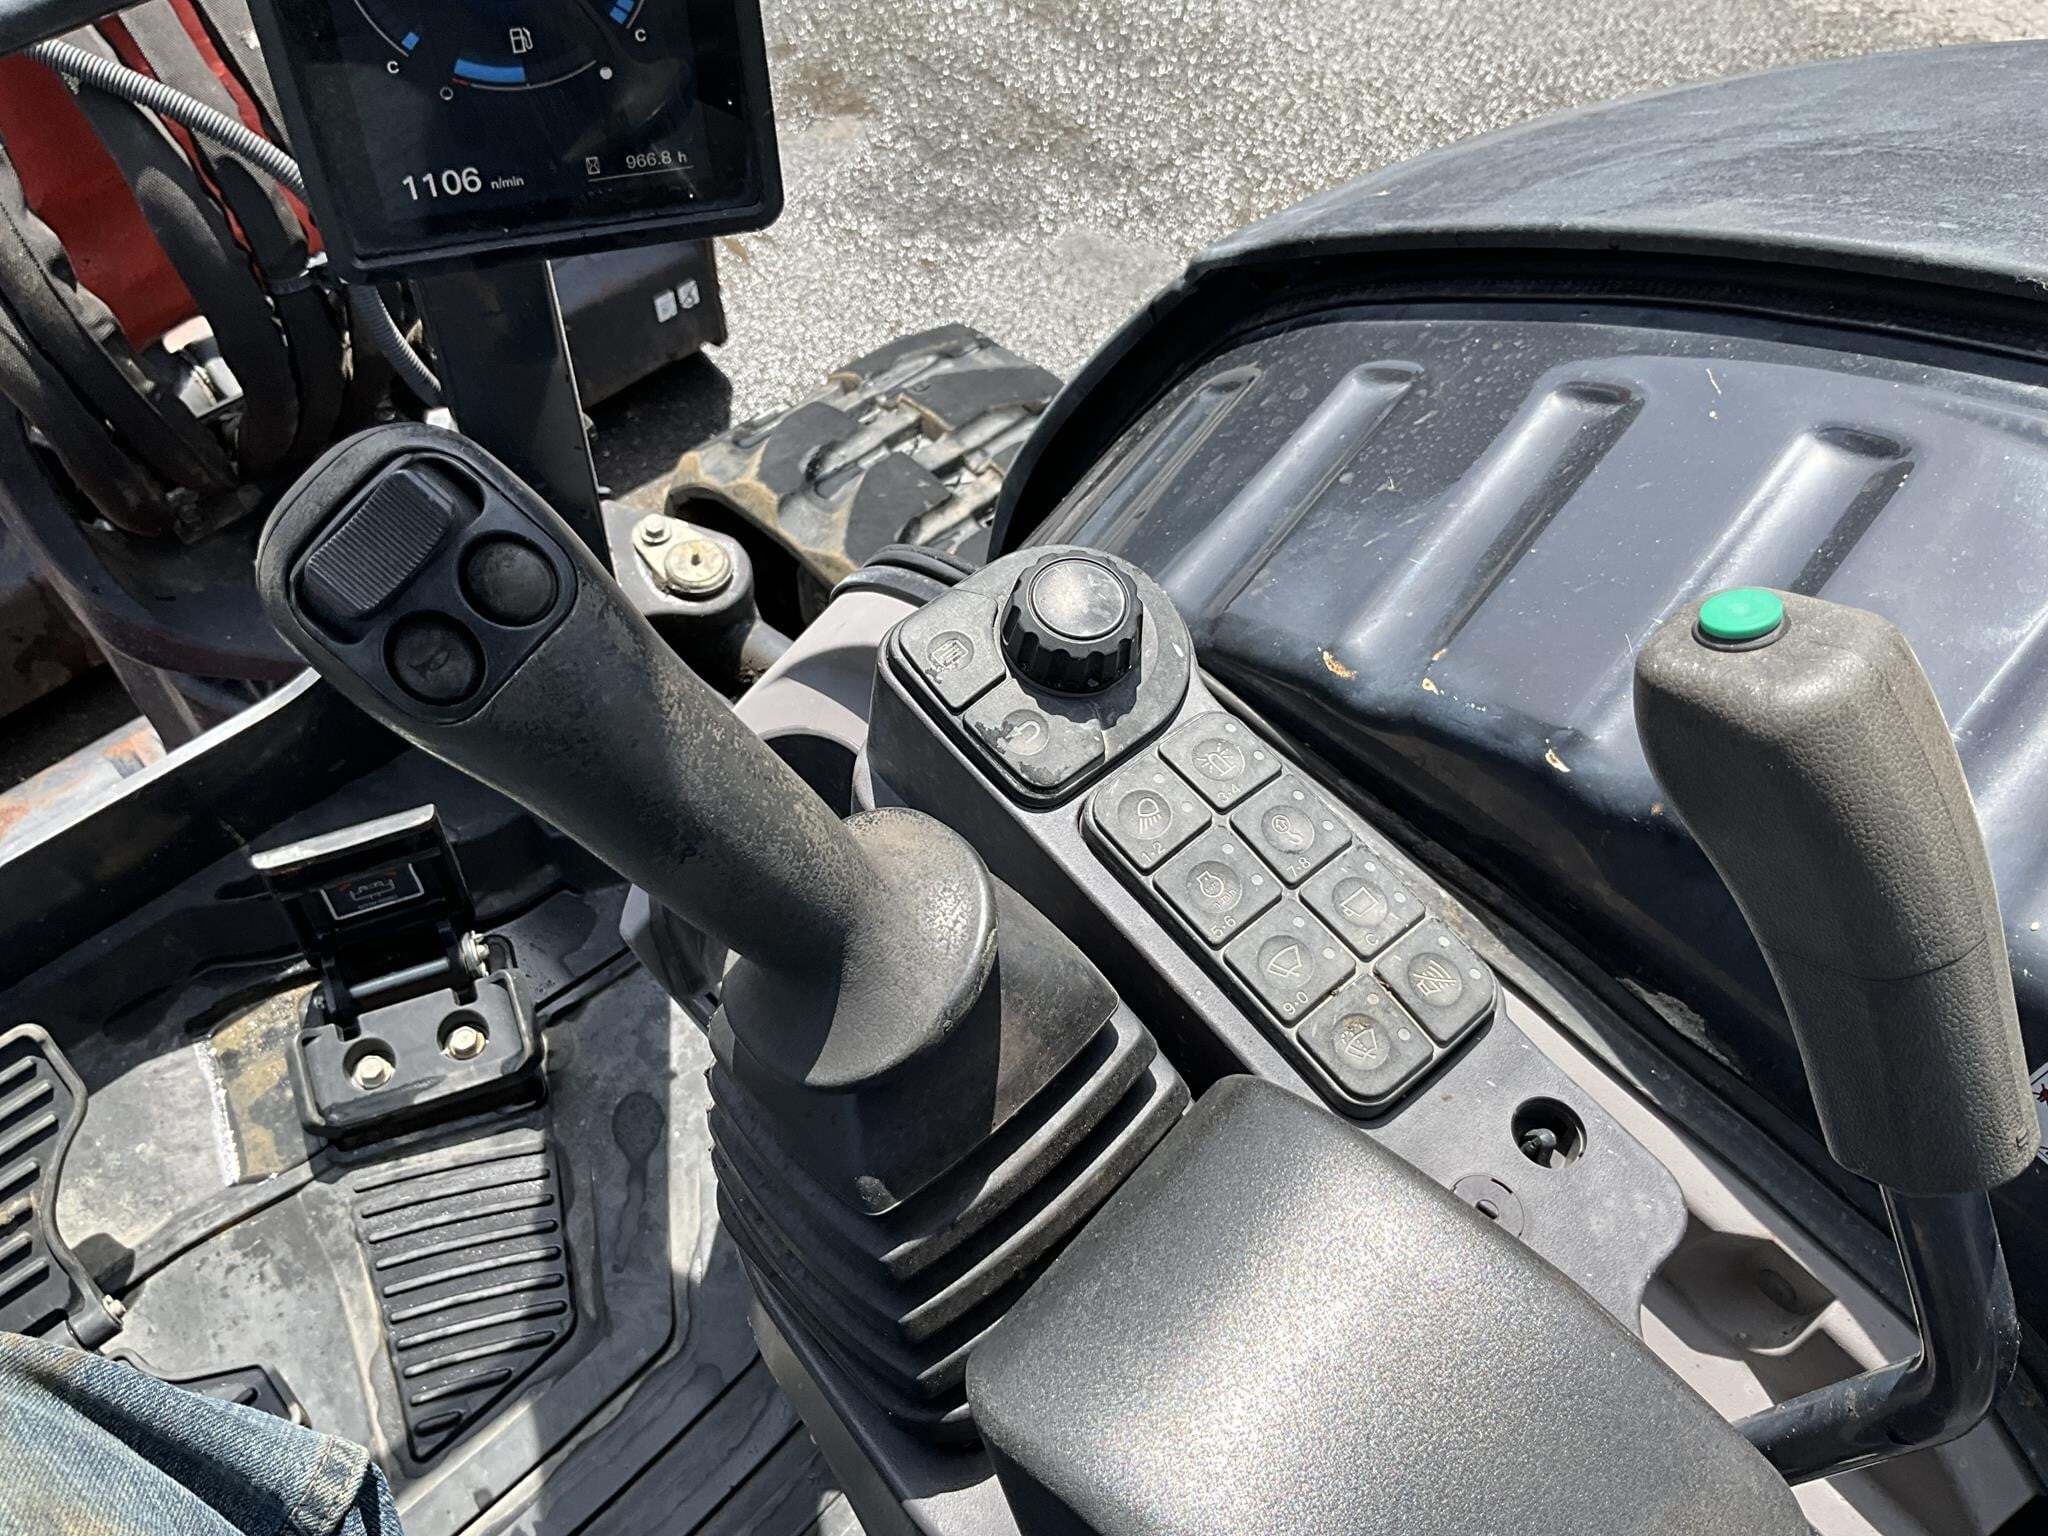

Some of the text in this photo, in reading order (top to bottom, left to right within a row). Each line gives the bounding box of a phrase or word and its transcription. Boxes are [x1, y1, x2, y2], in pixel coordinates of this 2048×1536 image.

[634, 28, 647, 42] C
[386, 60, 400, 74] C
[625, 150, 688, 169] 966.8 h
[402, 166, 525, 200] 1106 n/min
